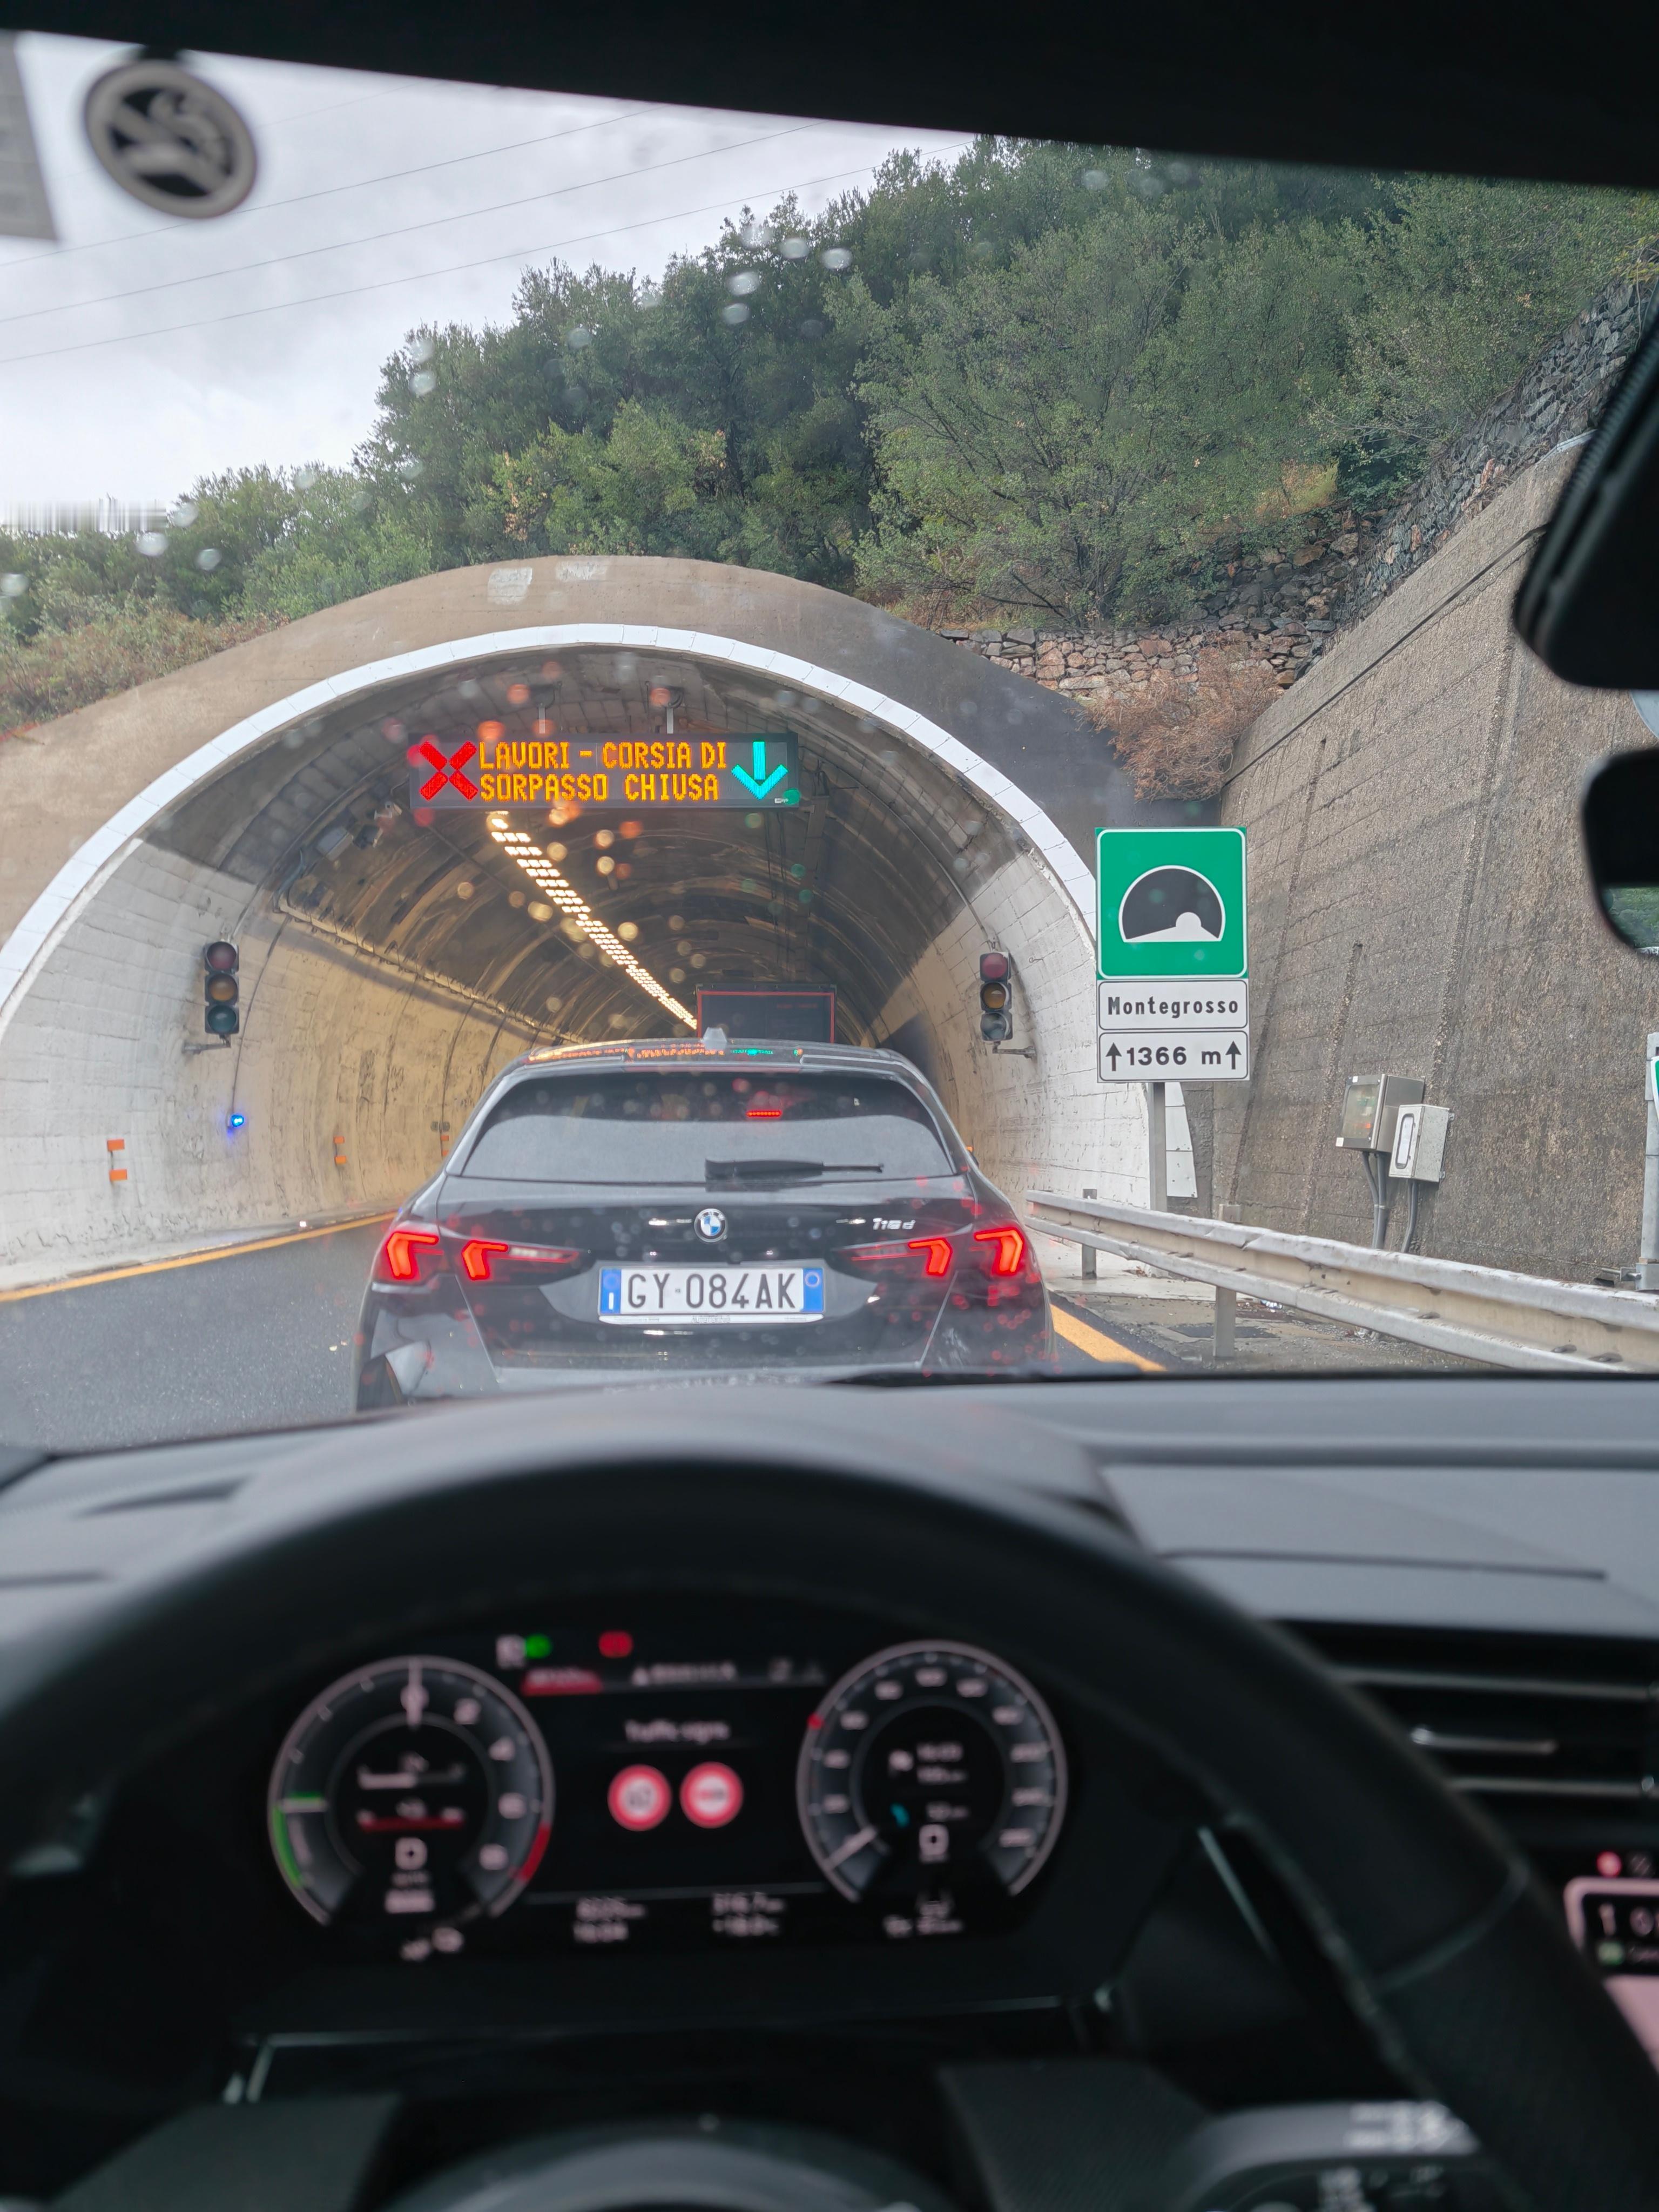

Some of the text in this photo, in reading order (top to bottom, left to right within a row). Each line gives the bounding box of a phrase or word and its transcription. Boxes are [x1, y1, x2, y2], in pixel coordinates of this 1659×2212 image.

[479, 741, 570, 770] LAVORI
[603, 741, 691, 769] CORSIA
[702, 741, 726, 769] DI
[480, 773, 718, 801] SORPASSO CHIUSA
[1108, 996, 1238, 1019] Montegrosso
[1127, 1046, 1221, 1065] 1366 m
[628, 1273, 795, 1309] GY 084AK
